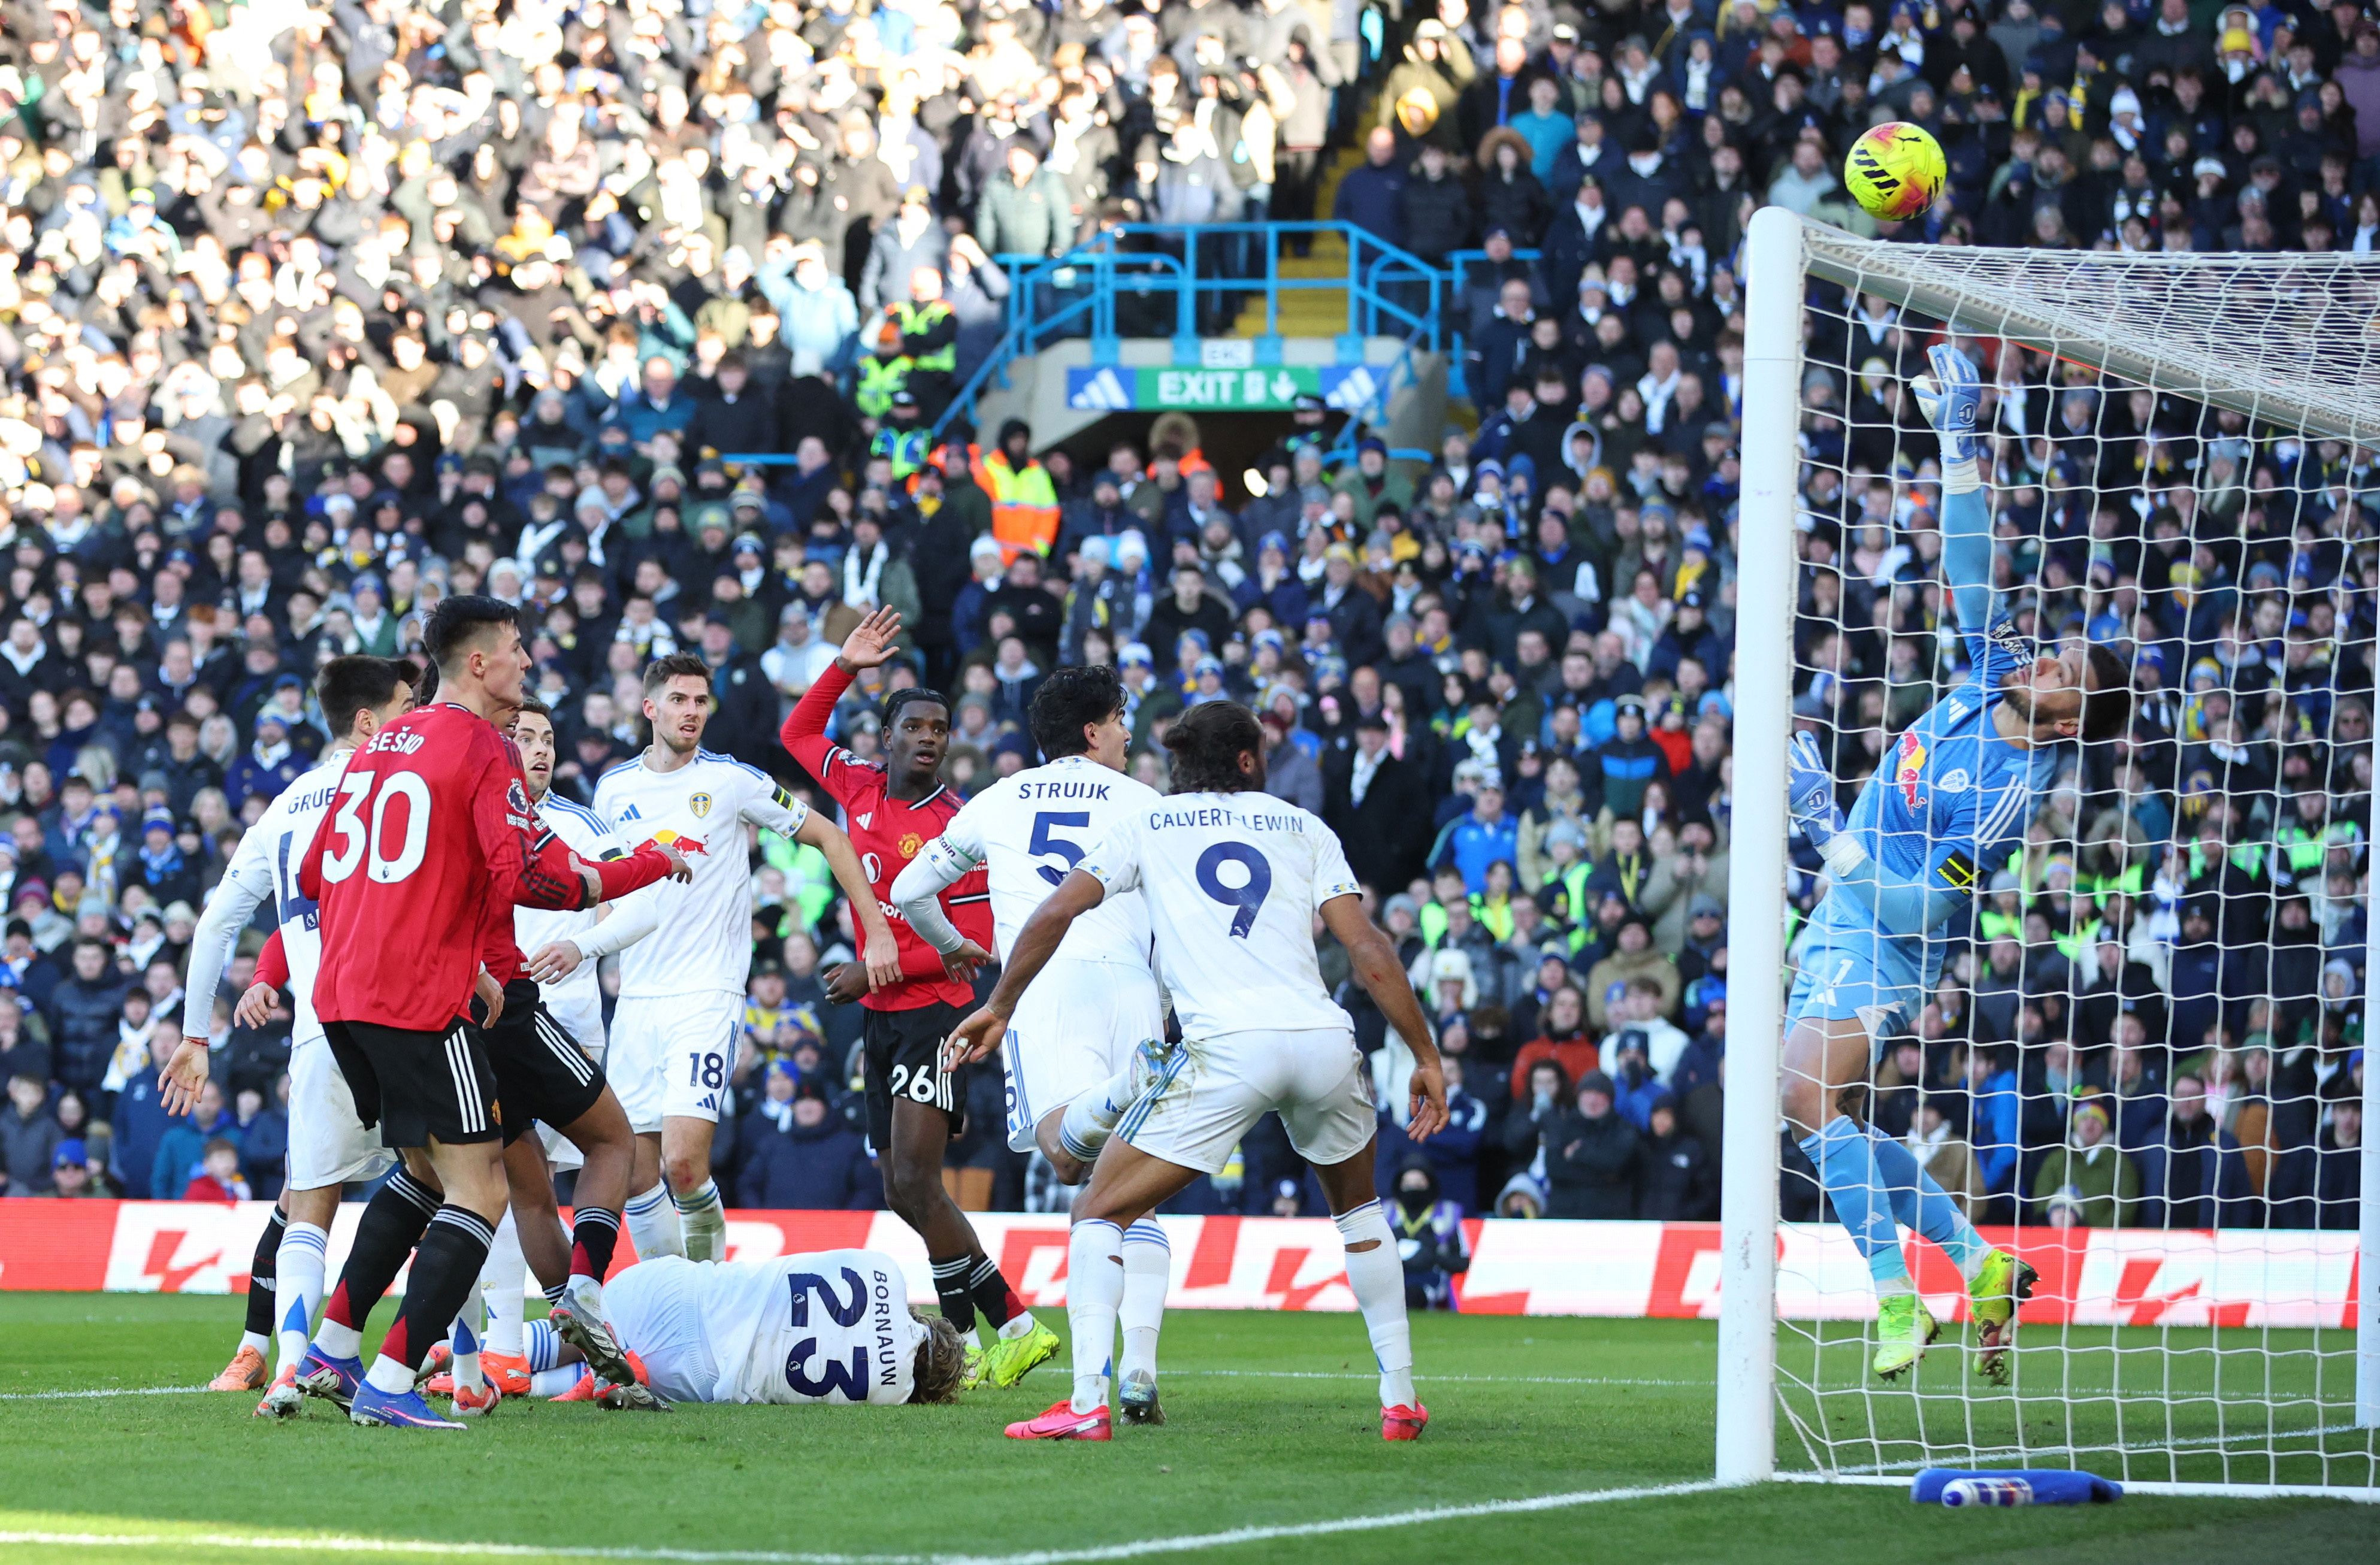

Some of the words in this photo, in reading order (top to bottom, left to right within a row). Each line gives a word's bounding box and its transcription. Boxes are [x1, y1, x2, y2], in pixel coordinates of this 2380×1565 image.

[1158, 371, 1239, 404] EXIT
[1018, 782, 1111, 801] STRUIJK
[322, 771, 431, 884] 30
[1150, 808, 1303, 833] CALVERT-LEWIN
[1028, 812, 1090, 886] 5
[1196, 841, 1271, 939] 9
[1831, 959, 1855, 987] 1
[689, 1052, 724, 1089] 18
[891, 1064, 936, 1103] 26
[785, 1266, 869, 1401] 23
[873, 1269, 896, 1387] BORNAUW
